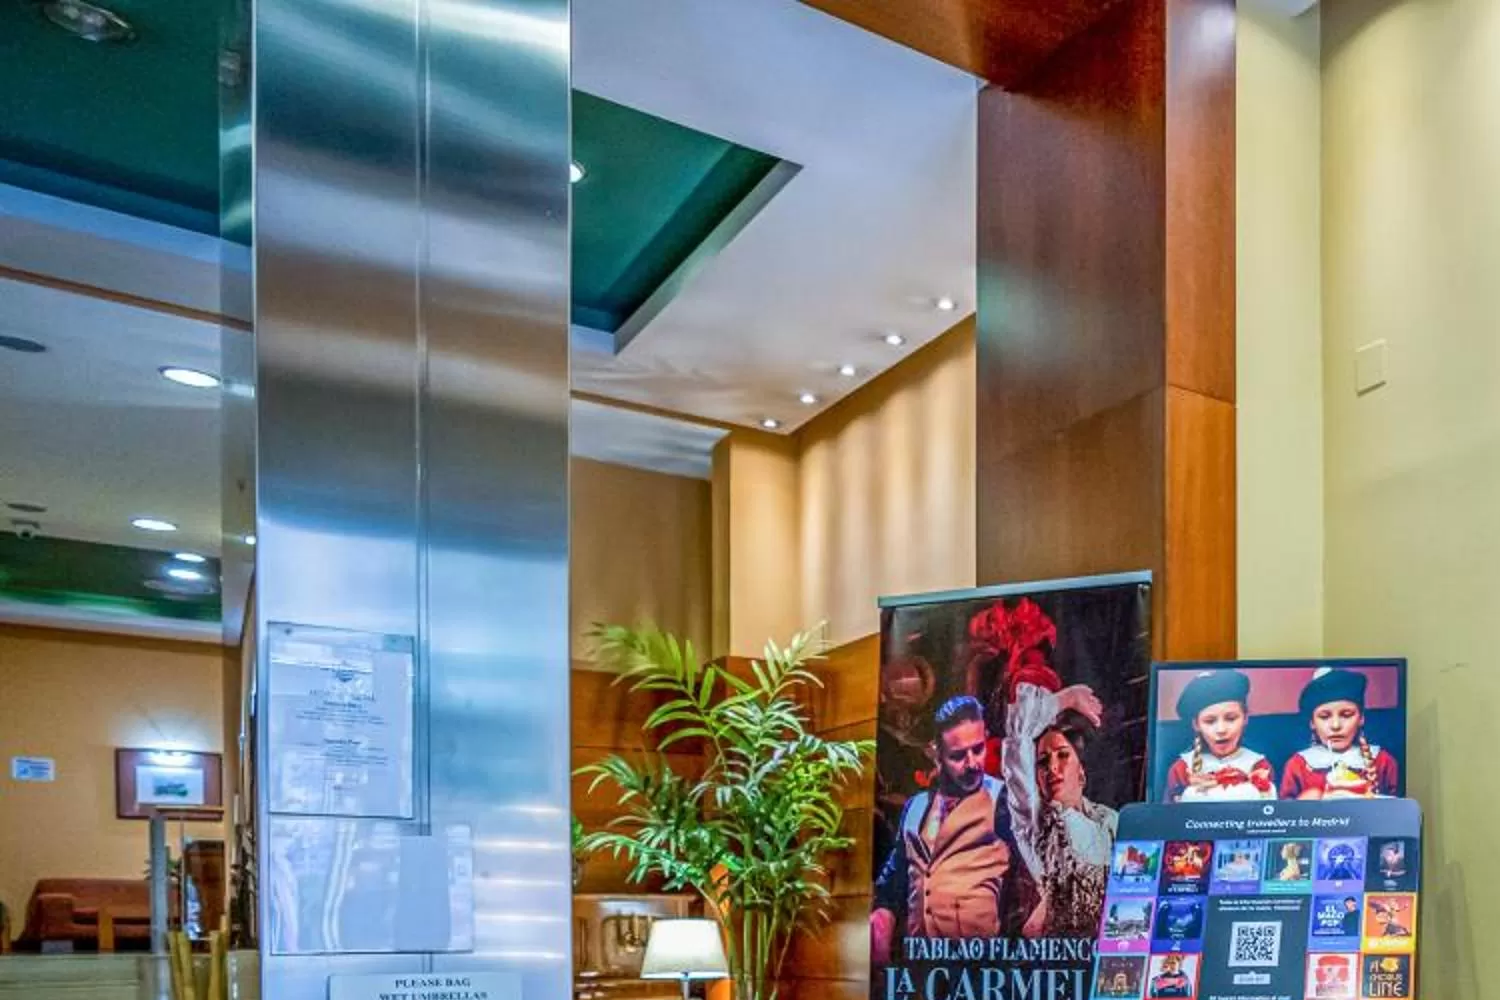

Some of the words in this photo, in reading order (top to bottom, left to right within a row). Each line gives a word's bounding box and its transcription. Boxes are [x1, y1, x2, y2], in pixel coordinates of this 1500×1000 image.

[1184, 818, 1245, 830] Connecting
[1311, 816, 1350, 827] Madrid
[904, 936, 984, 961] TABLAO
[989, 936, 1098, 962] FLAMENC
[395, 978, 443, 989] PLEASE
[445, 977, 471, 988] BAG
